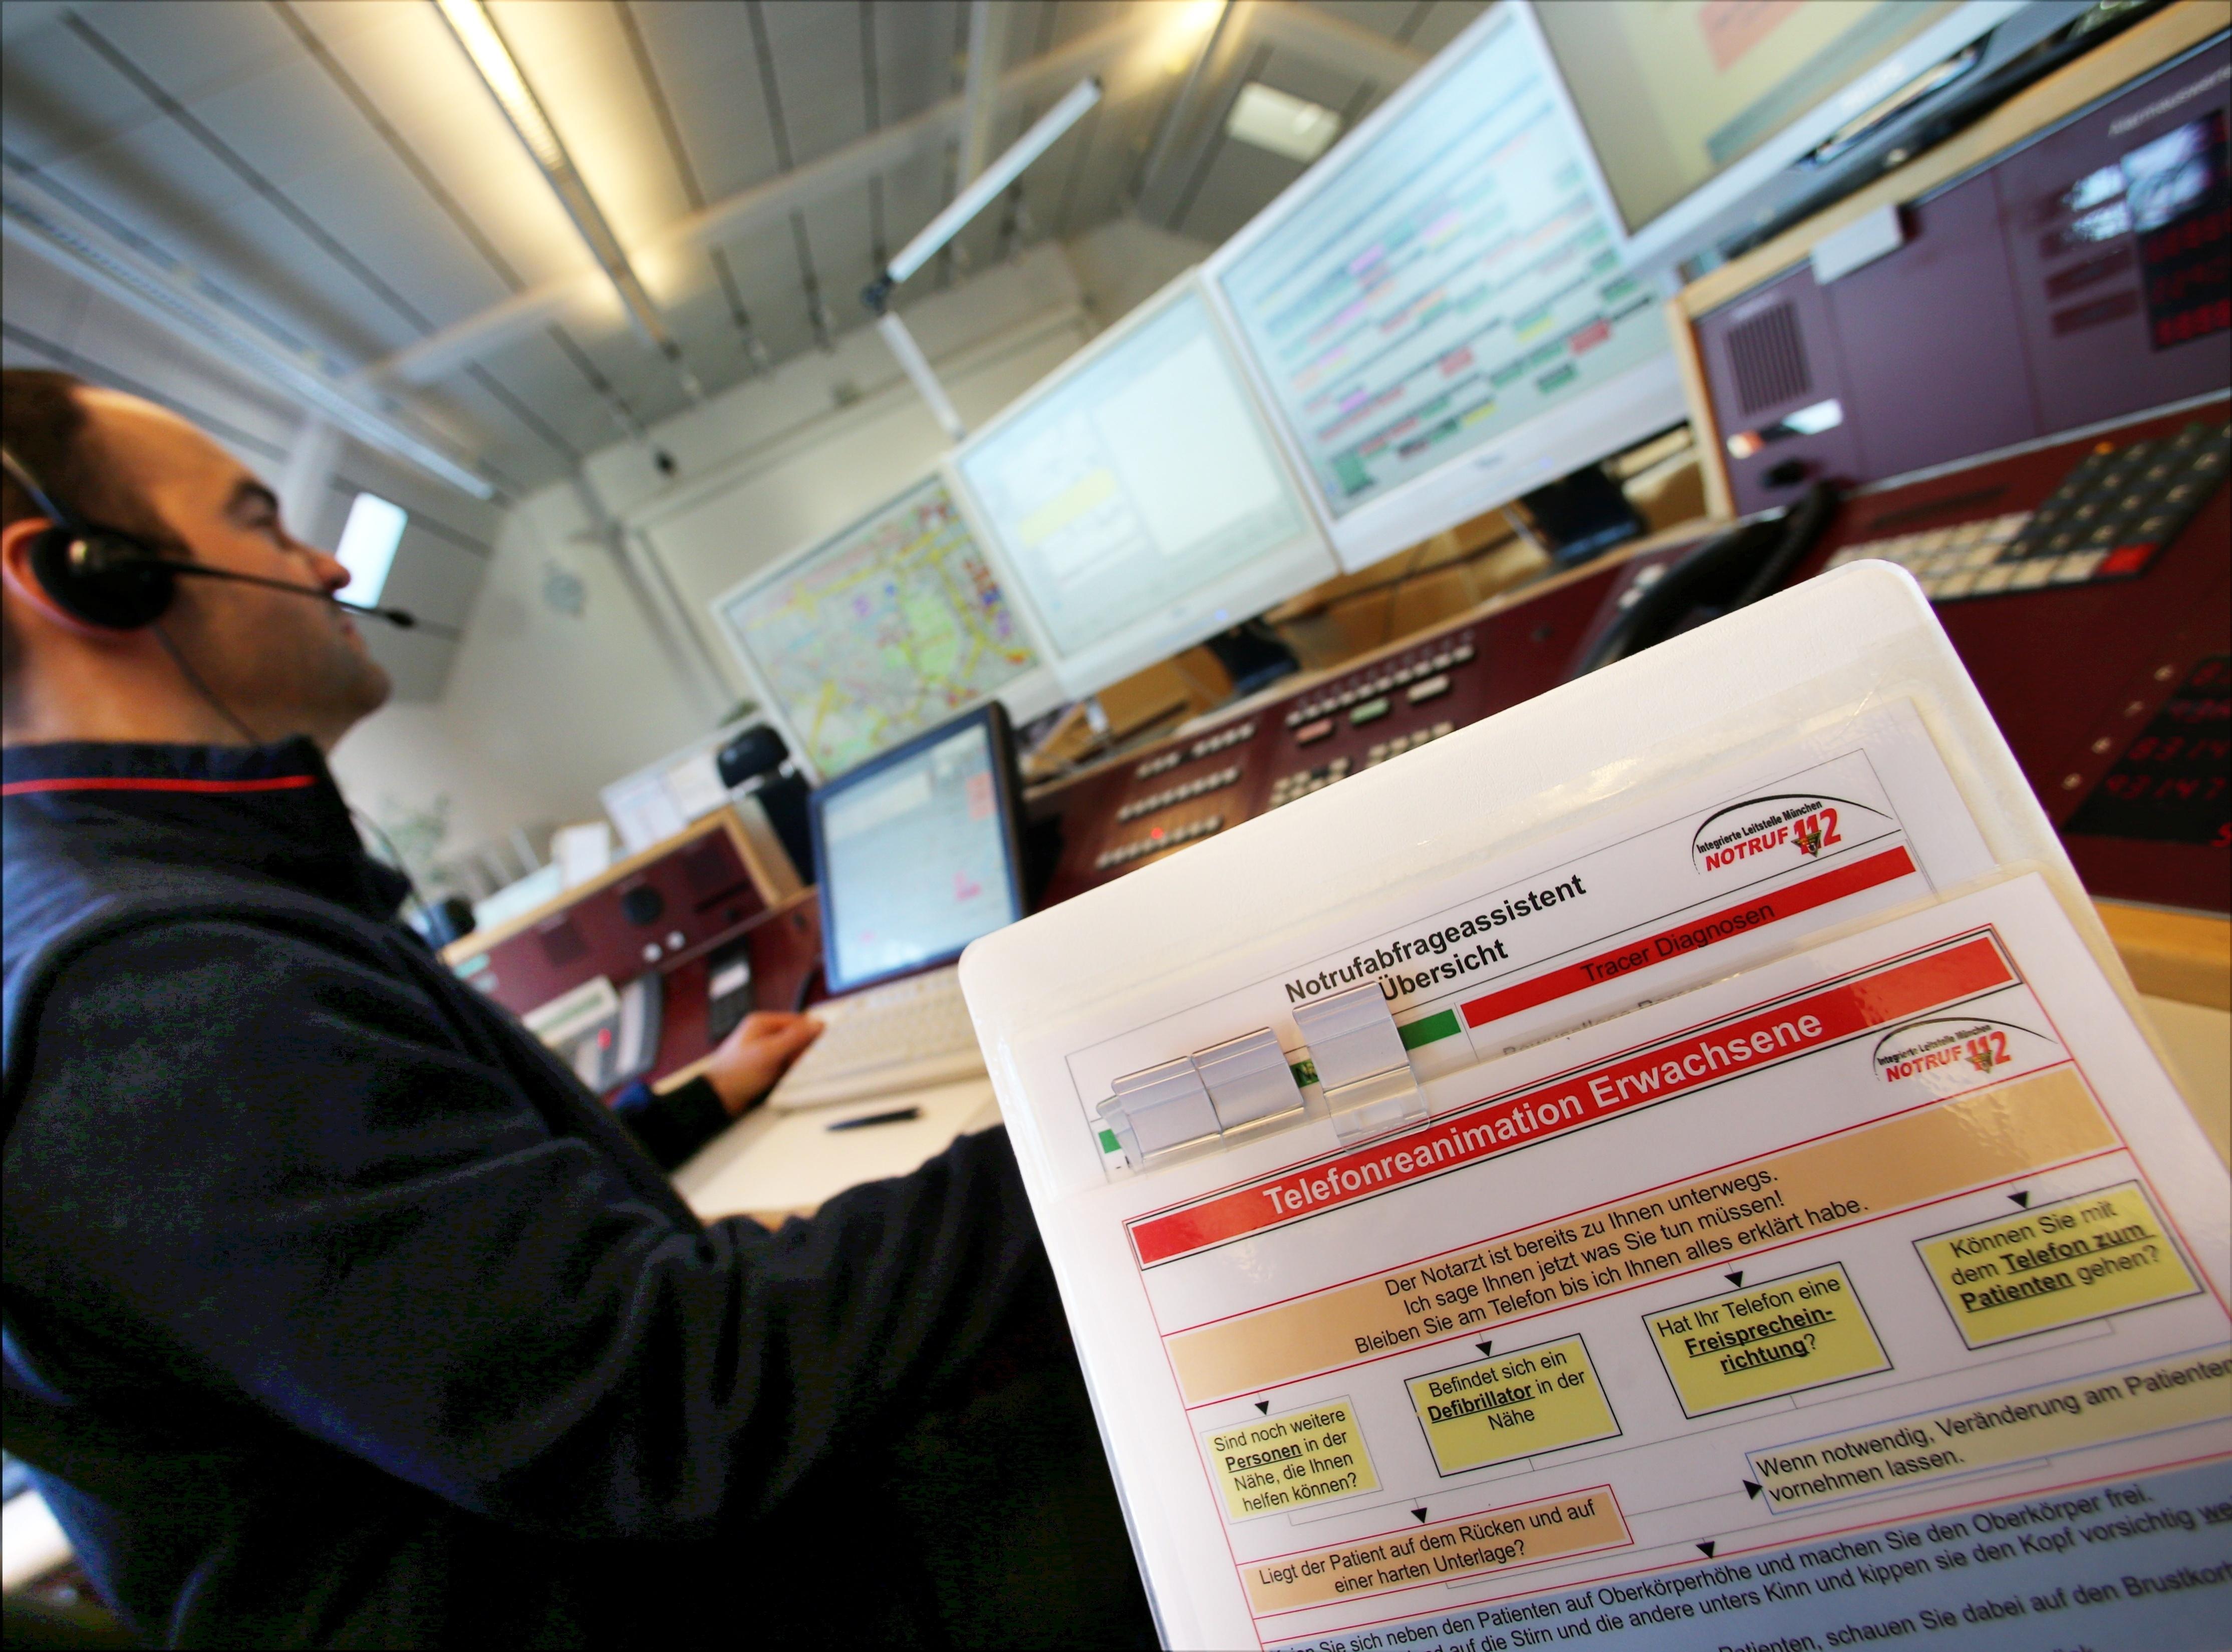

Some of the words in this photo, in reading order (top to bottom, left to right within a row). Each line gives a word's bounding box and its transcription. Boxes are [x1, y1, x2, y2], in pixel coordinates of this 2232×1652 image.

[1697, 830, 1741, 853] Integrierte
[1741, 815, 1782, 836] Leitstelle
[1782, 801, 1822, 822] München
[1705, 827, 1788, 871] NOTRUF
[1793, 808, 1841, 856] 112
[1285, 874, 1586, 1003] Notrufabfrageassistent
[1580, 948, 1649, 982] Tracer
[1654, 905, 1775, 957] Diagnosen
[1378, 939, 1508, 1000] Übersicht
[1877, 1048, 1918, 1065] Integrierte
[1886, 1045, 1962, 1082] NOTRUF
[1967, 1031, 2012, 1071] 112
[1262, 1092, 1584, 1215] Telefonreanimation
[1590, 1014, 1823, 1108] Erwachsene
[1384, 1275, 1416, 1296] Der
[1421, 1254, 1487, 1285] Notarzt
[1489, 1246, 1512, 1265] ist
[1514, 1229, 1577, 1258] bereits
[1581, 1221, 1605, 1238] zu
[1608, 1203, 1664, 1229] Ihnen
[1667, 1170, 1778, 1211] unterwegs.
[1404, 1293, 1431, 1315] Ich
[1436, 1283, 1479, 1306] sage
[1482, 1268, 1534, 1293] Ihnen
[1538, 1256, 1579, 1282] jetzt
[1582, 1241, 1620, 1263] was
[1624, 1230, 1657, 1251] Sie
[1660, 1220, 1693, 1240] tun
[1698, 1190, 1785, 1229] müssen!
[1949, 1224, 2036, 1258] Können
[2037, 1214, 2075, 1234] Sie
[2080, 1200, 2118, 1223] mit
[1951, 1260, 2000, 1285] dem
[2000, 1239, 2089, 1274] Telefon
[2093, 1223, 2147, 1249] zum
[1355, 1320, 1421, 1353] Bleiben
[1424, 1313, 1453, 1334] Sie
[1458, 1308, 1486, 1325] am
[1488, 1286, 1557, 1315] Telefon
[1559, 1277, 1588, 1297] bis
[1592, 1266, 1622, 1287] ich
[1624, 1252, 1682, 1277] Ihnen
[1688, 1235, 1733, 1261] alles
[1738, 1214, 1803, 1245] erklärt
[1805, 1200, 1868, 1225] habe.
[1959, 1271, 2076, 1312] Patienten
[2077, 1245, 2160, 1285] gehen?
[1657, 1316, 1693, 1337] Hat
[1694, 1309, 1719, 1327] Ihr
[1722, 1289, 1794, 1319] Telefon
[1799, 1278, 1840, 1299] eine
[1684, 1307, 1835, 1357] Freisprechein-
[1429, 1367, 1499, 1398] Befindet
[1502, 1359, 1536, 1379] sich
[1540, 1351, 1567, 1368] ein
[1720, 1333, 1816, 1374] richtung?
[1427, 1384, 1535, 1423] Defibrillator
[1535, 1379, 1553, 1395] in
[1557, 1370, 1585, 1389] der
[1488, 1409, 1535, 1430] Nähe
[1214, 1432, 1247, 1452] Sind
[1251, 1423, 1287, 1443] noch
[1290, 1410, 1345, 1433] weitere
[1225, 1444, 1302, 1473] Personen
[1304, 1438, 1319, 1452] in
[1323, 1432, 1346, 1447] der
[1756, 1452, 1818, 1478] Wenn
[1821, 1428, 1935, 1464] notwendig,
[1935, 1394, 2081, 1438] Veränderung
[2084, 1385, 2123, 1406] am
[1234, 1472, 1280, 1491] Nähe,
[1283, 1464, 1306, 1480] die
[1309, 1454, 1353, 1474] Ihnen
[1243, 1491, 1289, 1512] helfen
[1292, 1472, 1356, 1499] können?
[1768, 1466, 1884, 1502] vornehmen
[1885, 1449, 1965, 1476] lassen.
[1259, 1564, 1297, 1584] Liegt
[1301, 1560, 1325, 1576] der
[1329, 1542, 1387, 1570] Patient
[1390, 1537, 1416, 1558] auf
[1420, 1530, 1457, 1552] dem
[1459, 1510, 1526, 1543] Rücken
[1530, 1505, 1563, 1527] und
[1566, 1499, 1596, 1520] auf
[1319, 1641, 1345, 1652] Sie
[1350, 1633, 1381, 1651] sich
[1387, 1625, 1438, 1646] neben
[1443, 1618, 1474, 1634] den
[1477, 1599, 1562, 1628] Patienten
[1566, 1591, 1596, 1611] auf
[1598, 1563, 1752, 1604] Oberkörperhöhe
[1756, 1552, 1795, 1576] und
[1800, 1539, 1880, 1567] machen
[1884, 1529, 1921, 1550] Sie
[1926, 1520, 1970, 1542] den
[1972, 1496, 2100, 1533] Oberkörper
[2105, 1484, 2153, 1508] frei.
[1334, 1574, 1373, 1593] einer
[1377, 1562, 1431, 1584] harten
[1433, 1539, 1525, 1573] Unterlage?
[1450, 1638, 1476, 1652] auf
[1481, 1635, 1507, 1652] die
[1511, 1627, 1553, 1647] Stirn
[1558, 1618, 1592, 1640] und
[1595, 1614, 1623, 1632] die
[1629, 1600, 1695, 1627] andere
[1702, 1587, 1761, 1614] unters
[1763, 1581, 1812, 1602] Kinn
[1815, 1569, 1854, 1592] und
[1858, 1557, 1930, 1584] kippen
[1935, 1550, 1967, 1570] sie
[1973, 1543, 2016, 1563] den
[2017, 1526, 2075, 1553] Kopf
[2079, 1508, 2197, 1543] vorsichtig
[2196, 1495, 2232, 1524] we
[1826, 1617, 1916, 1647] schauen
[1918, 1609, 1958, 1630] Sie
[1961, 1595, 2027, 1624] dabei
[2030, 1587, 2068, 1613] auf
[2073, 1583, 2120, 1605] den
